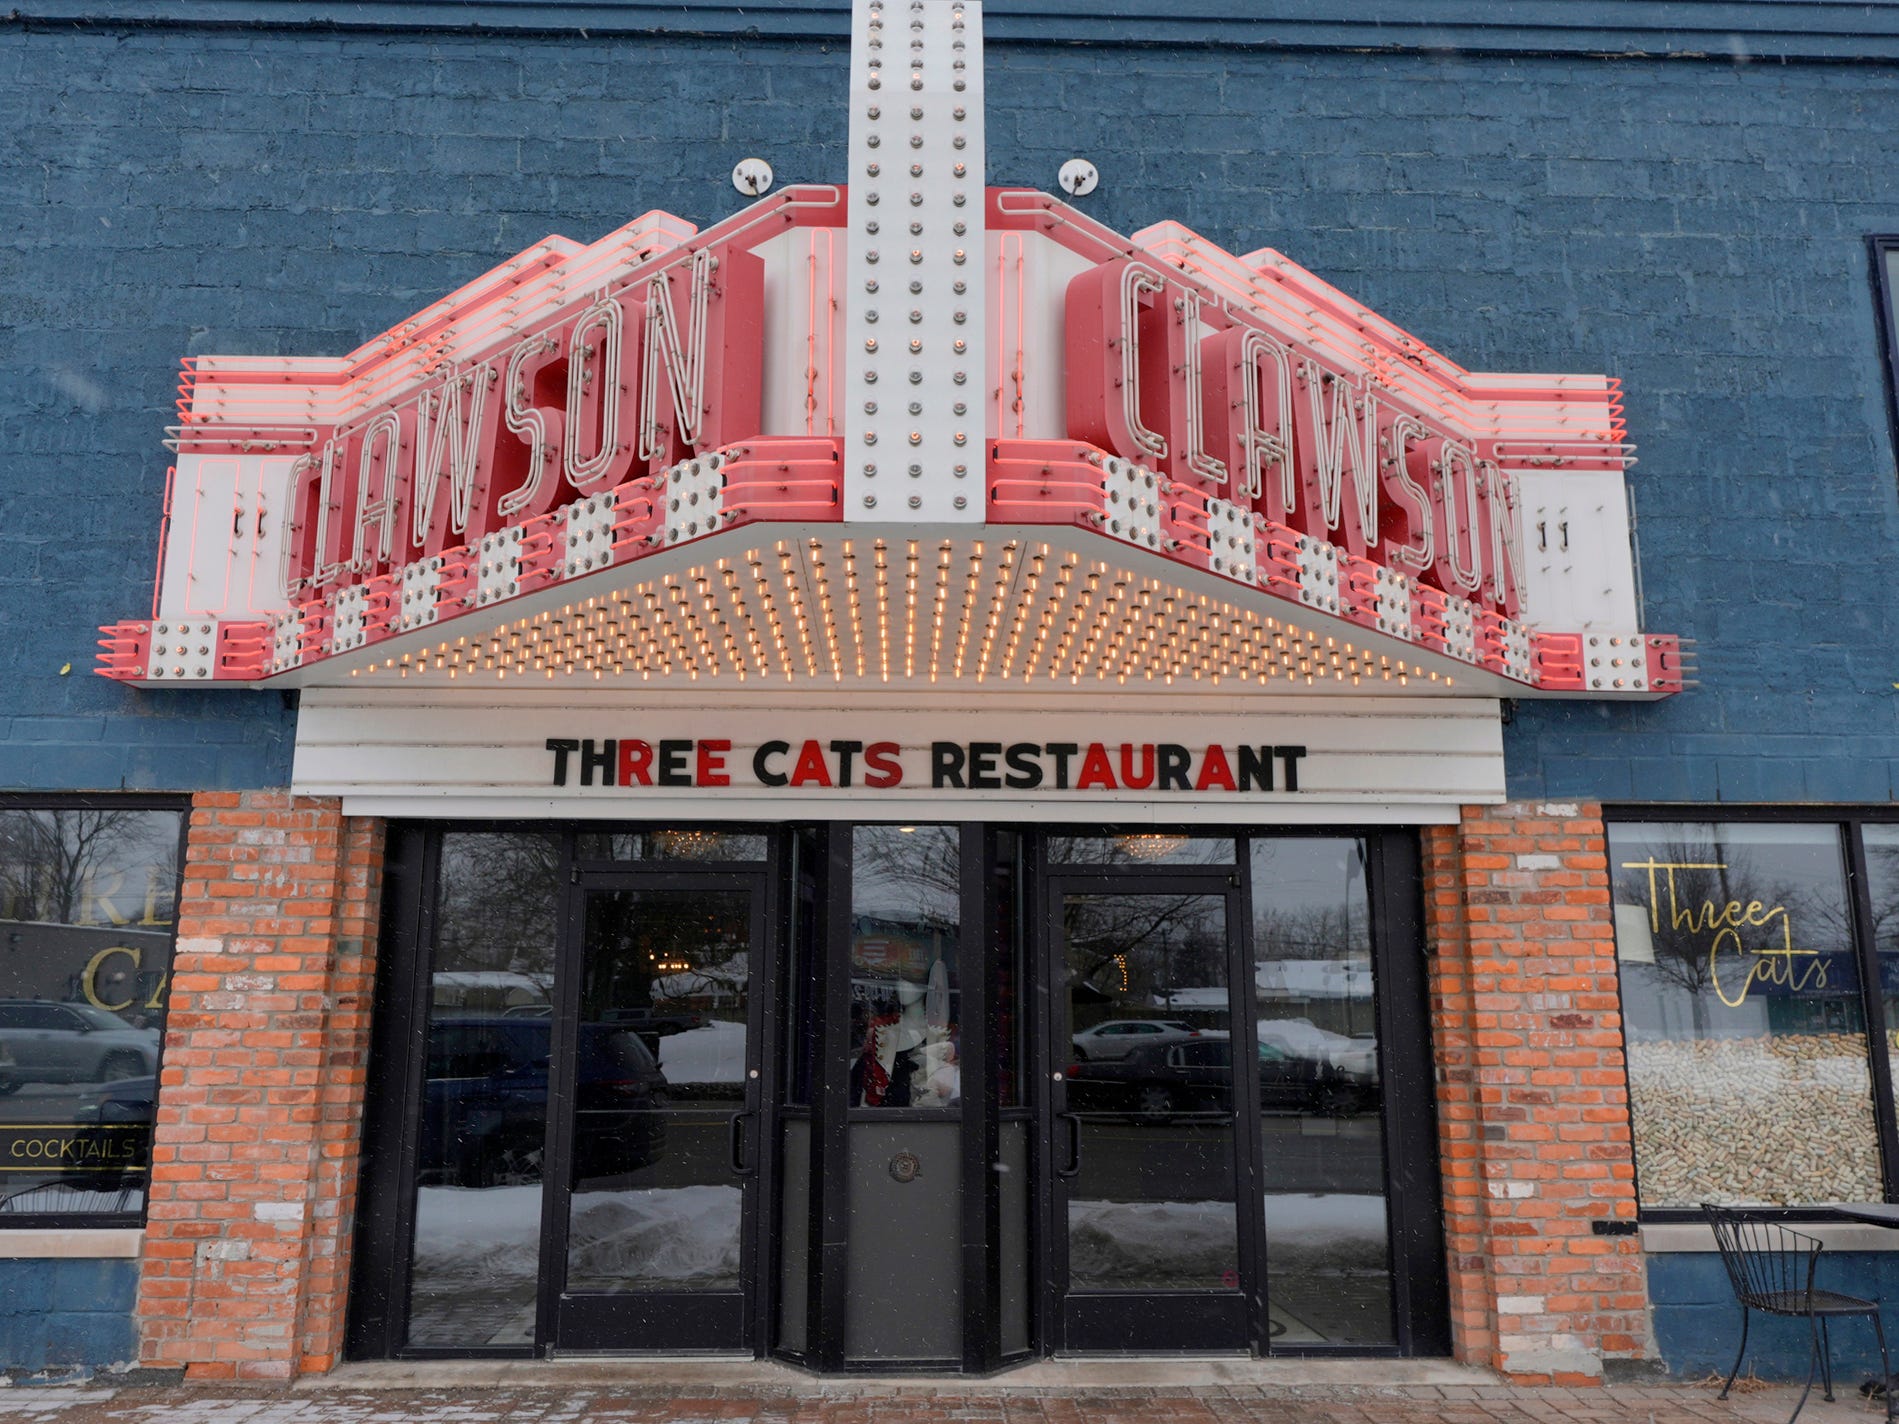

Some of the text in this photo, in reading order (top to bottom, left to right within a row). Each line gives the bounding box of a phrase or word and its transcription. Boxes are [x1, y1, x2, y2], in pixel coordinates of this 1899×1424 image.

[279, 245, 735, 606] CLAWSON
[1095, 255, 1529, 617] CLAWSON
[546, 738, 1307, 792] THREE CATS RESTAURANT
[1621, 856, 1785, 934] Three
[1710, 912, 1832, 1008] Cats
[11, 1139, 136, 1159] COCKTAILS
